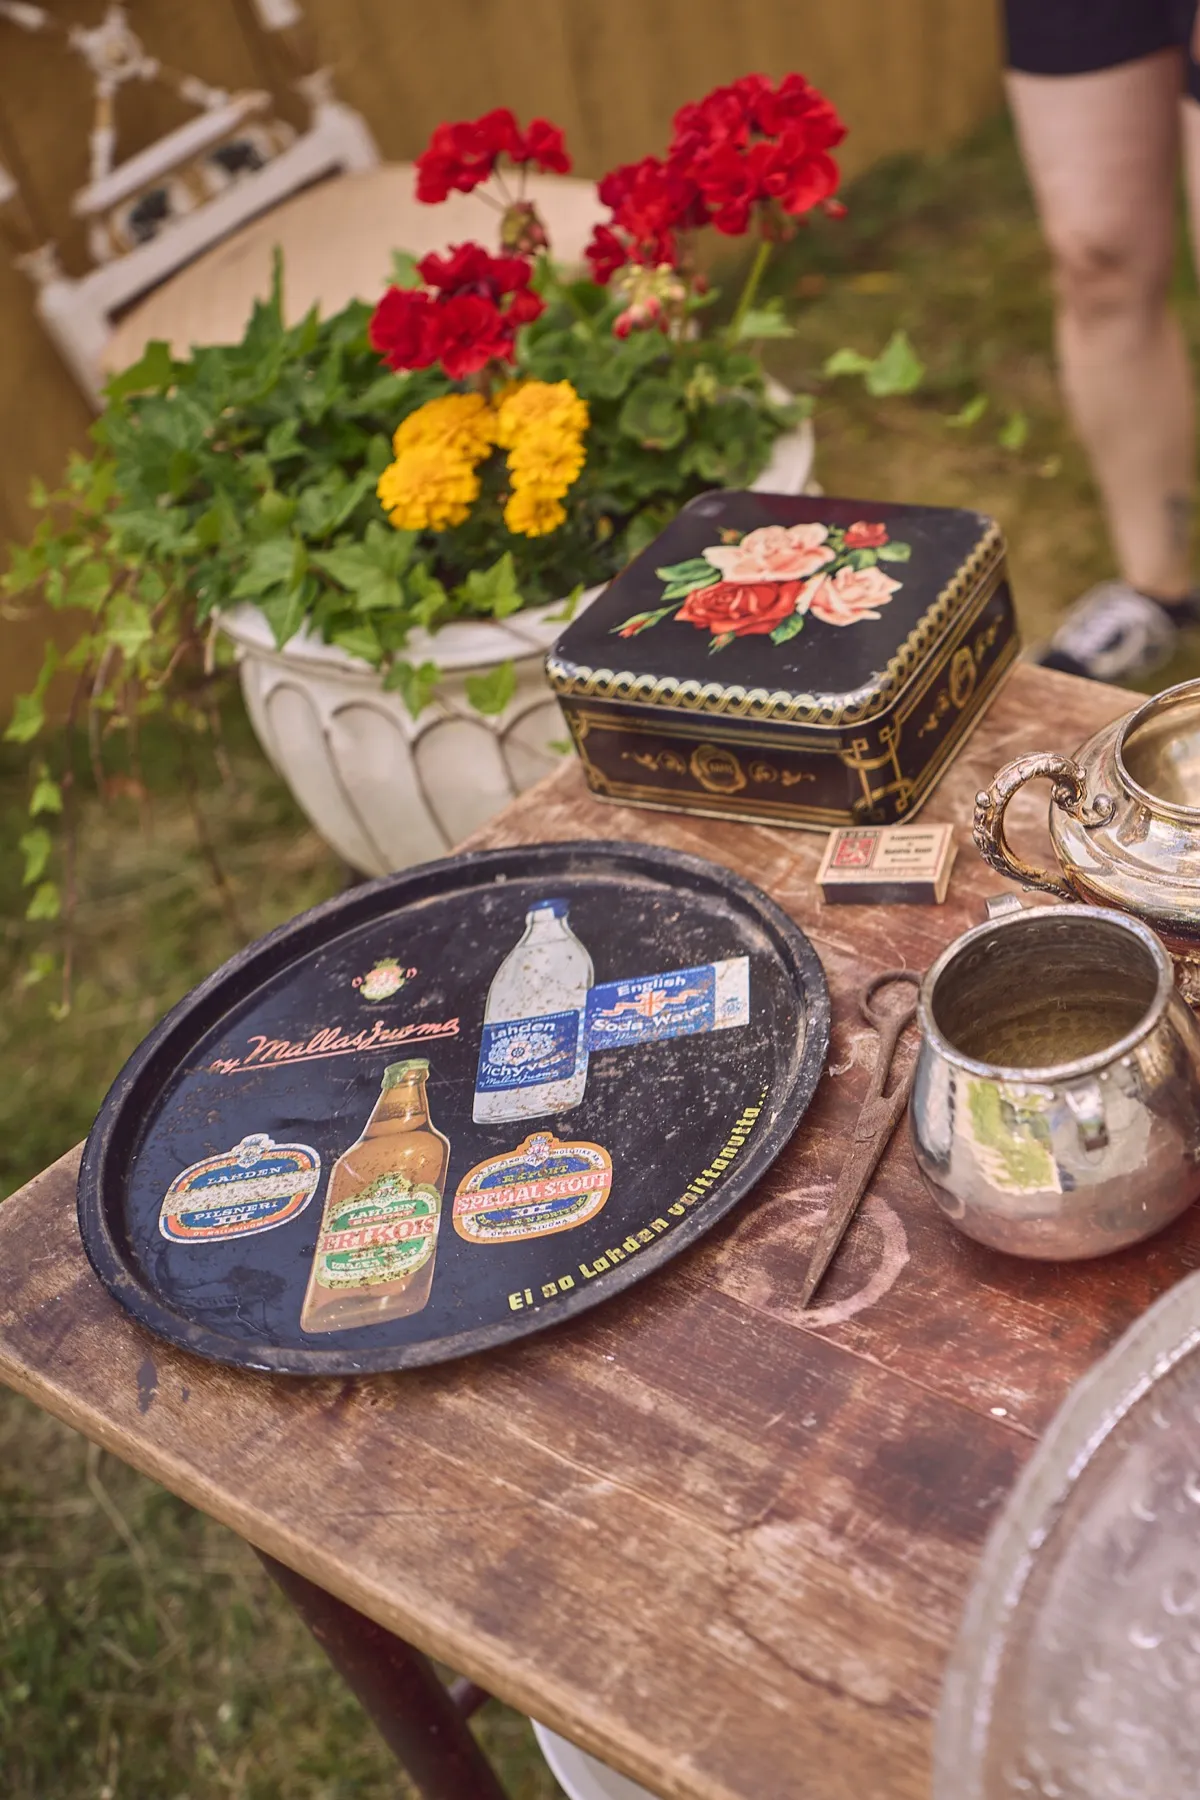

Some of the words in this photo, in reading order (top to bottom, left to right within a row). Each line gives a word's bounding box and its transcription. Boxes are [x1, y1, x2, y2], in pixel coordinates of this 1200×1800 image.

[617, 977, 686, 997] English
[591, 1003, 710, 1032] Soda-Water
[491, 1022, 556, 1041] Lahden
[207, 1165, 283, 1185] LAHDEN
[455, 1184, 543, 1212] SPECIAL
[543, 1173, 609, 1196] STOUT
[193, 1201, 279, 1221] PILSNERI
[348, 1202, 417, 1220] LAHDEN
[508, 1288, 534, 1311] Ei
[578, 1216, 670, 1279] Lahden
